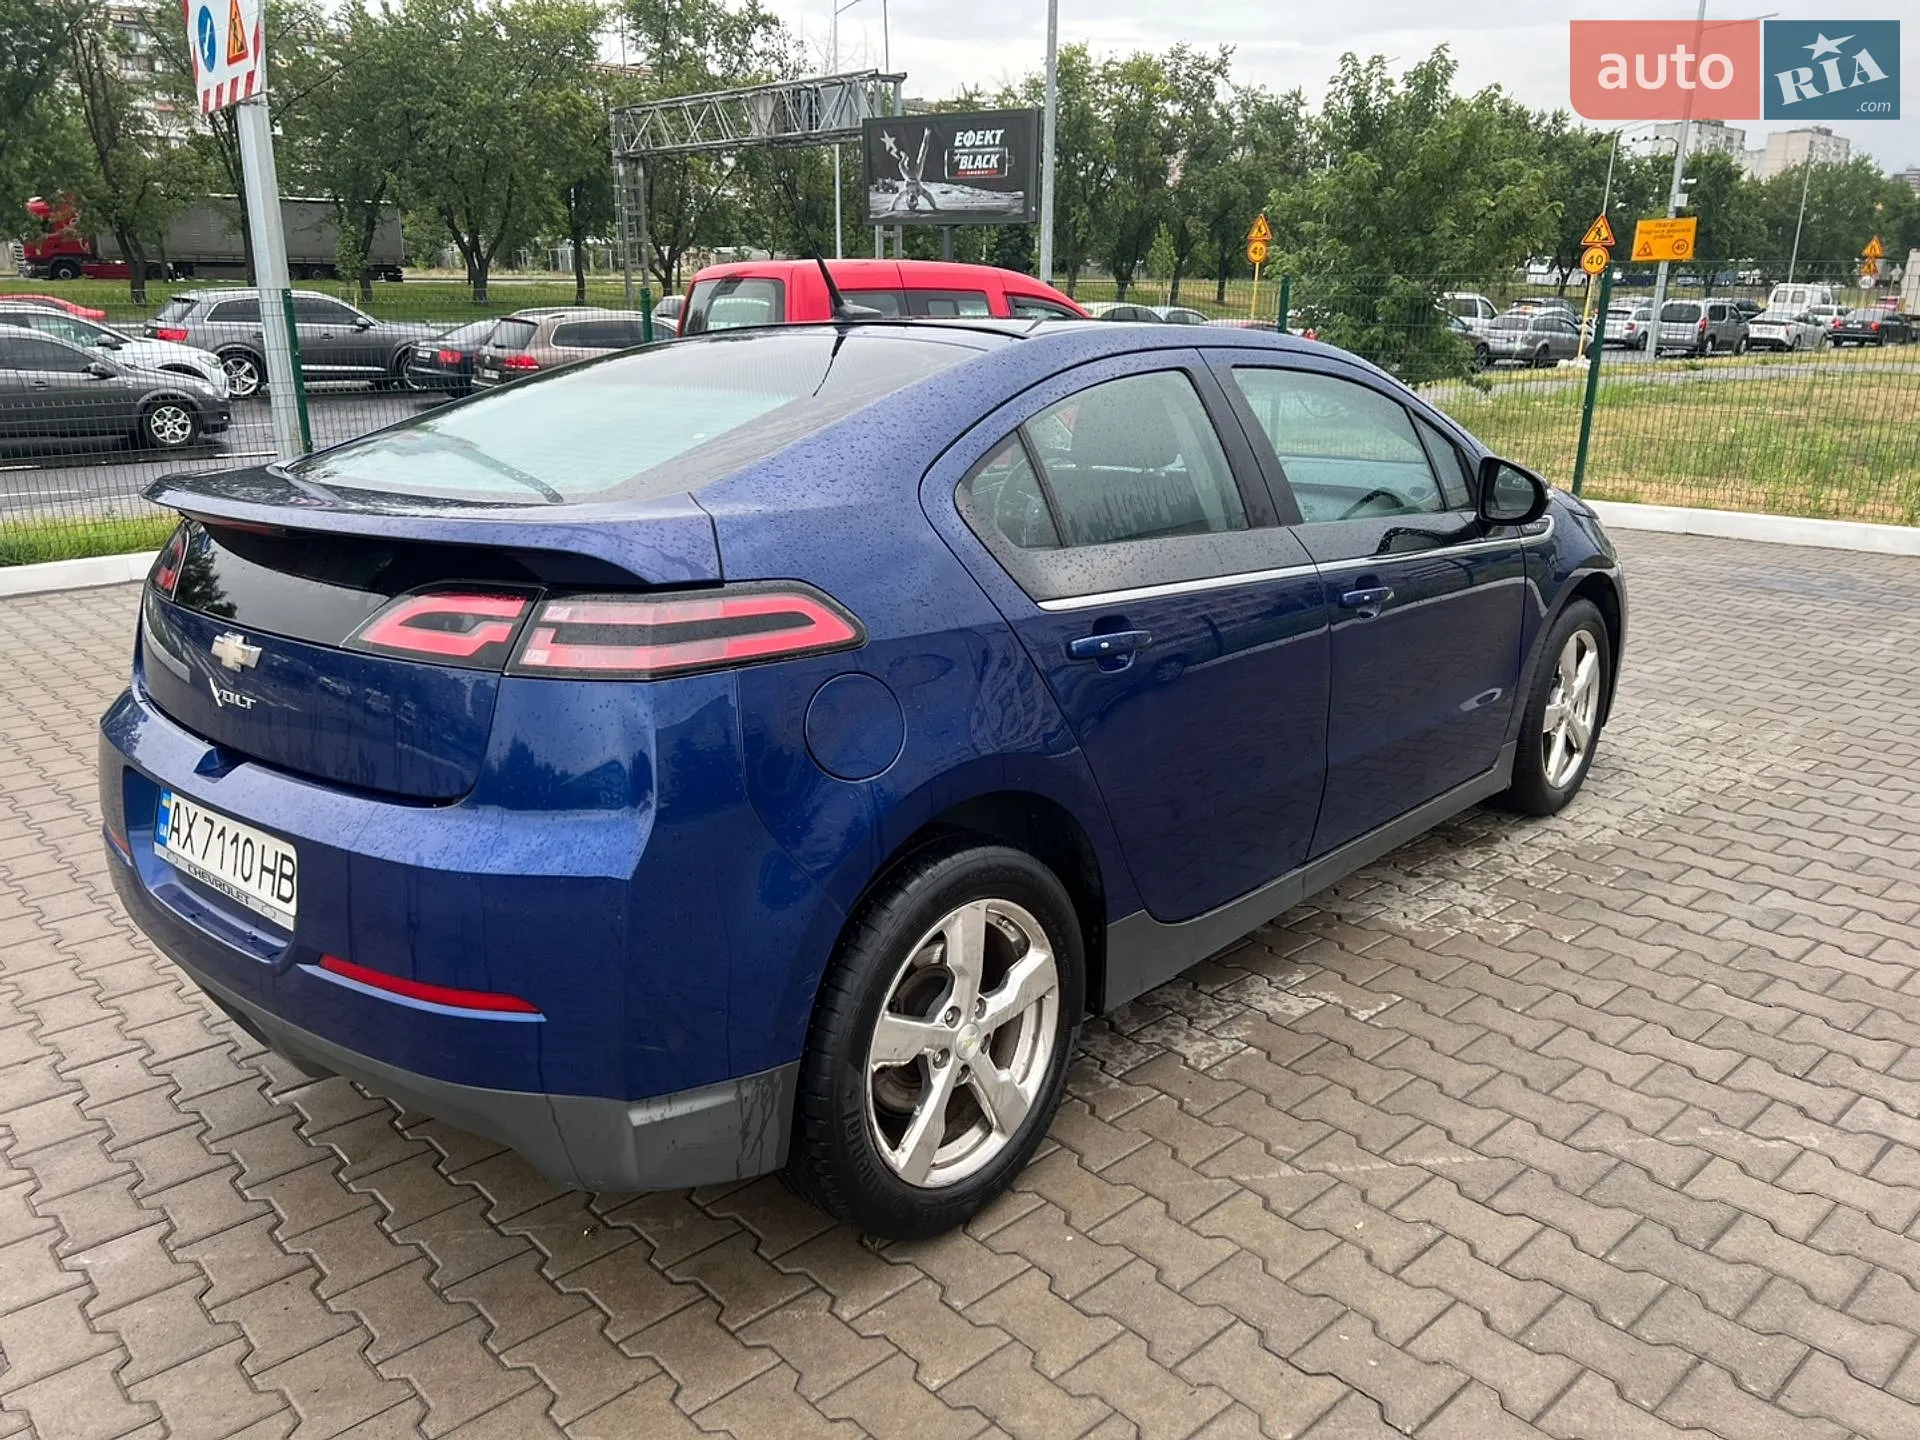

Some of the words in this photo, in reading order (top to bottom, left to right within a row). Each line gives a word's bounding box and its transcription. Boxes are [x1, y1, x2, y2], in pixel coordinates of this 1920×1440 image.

[954, 129, 1005, 147] ЕФЕКТ
[958, 154, 999, 169] BLACK
[1252, 246, 1264, 256] 40
[1587, 254, 1604, 266] 40
[209, 677, 257, 709] VOLT
[168, 801, 198, 855] AX
[202, 816, 255, 883] 7110
[258, 844, 296, 904] HB
[187, 863, 250, 905] CHEVROLET
